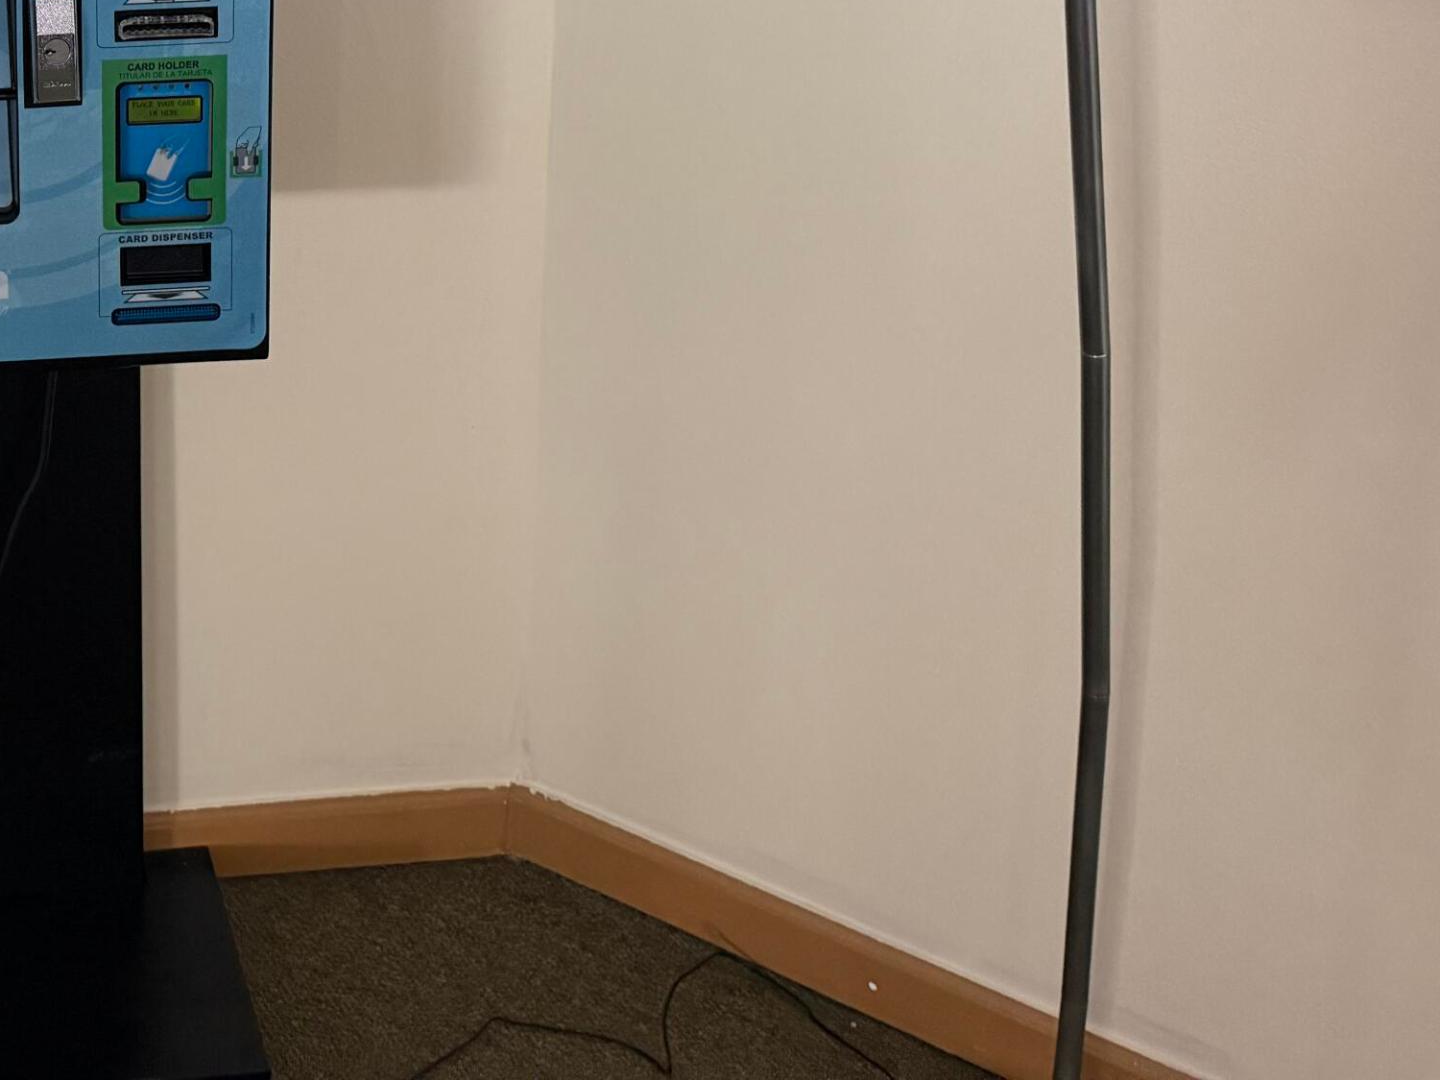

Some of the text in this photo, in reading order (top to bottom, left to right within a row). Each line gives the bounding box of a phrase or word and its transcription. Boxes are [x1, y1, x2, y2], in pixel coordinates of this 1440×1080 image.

[127, 60, 200, 72] CARD HOLDER
[119, 71, 152, 80] TITULAR
[153, 71, 164, 79] DE
[165, 70, 176, 79] LA
[118, 231, 214, 244] CARD DISPENSER
